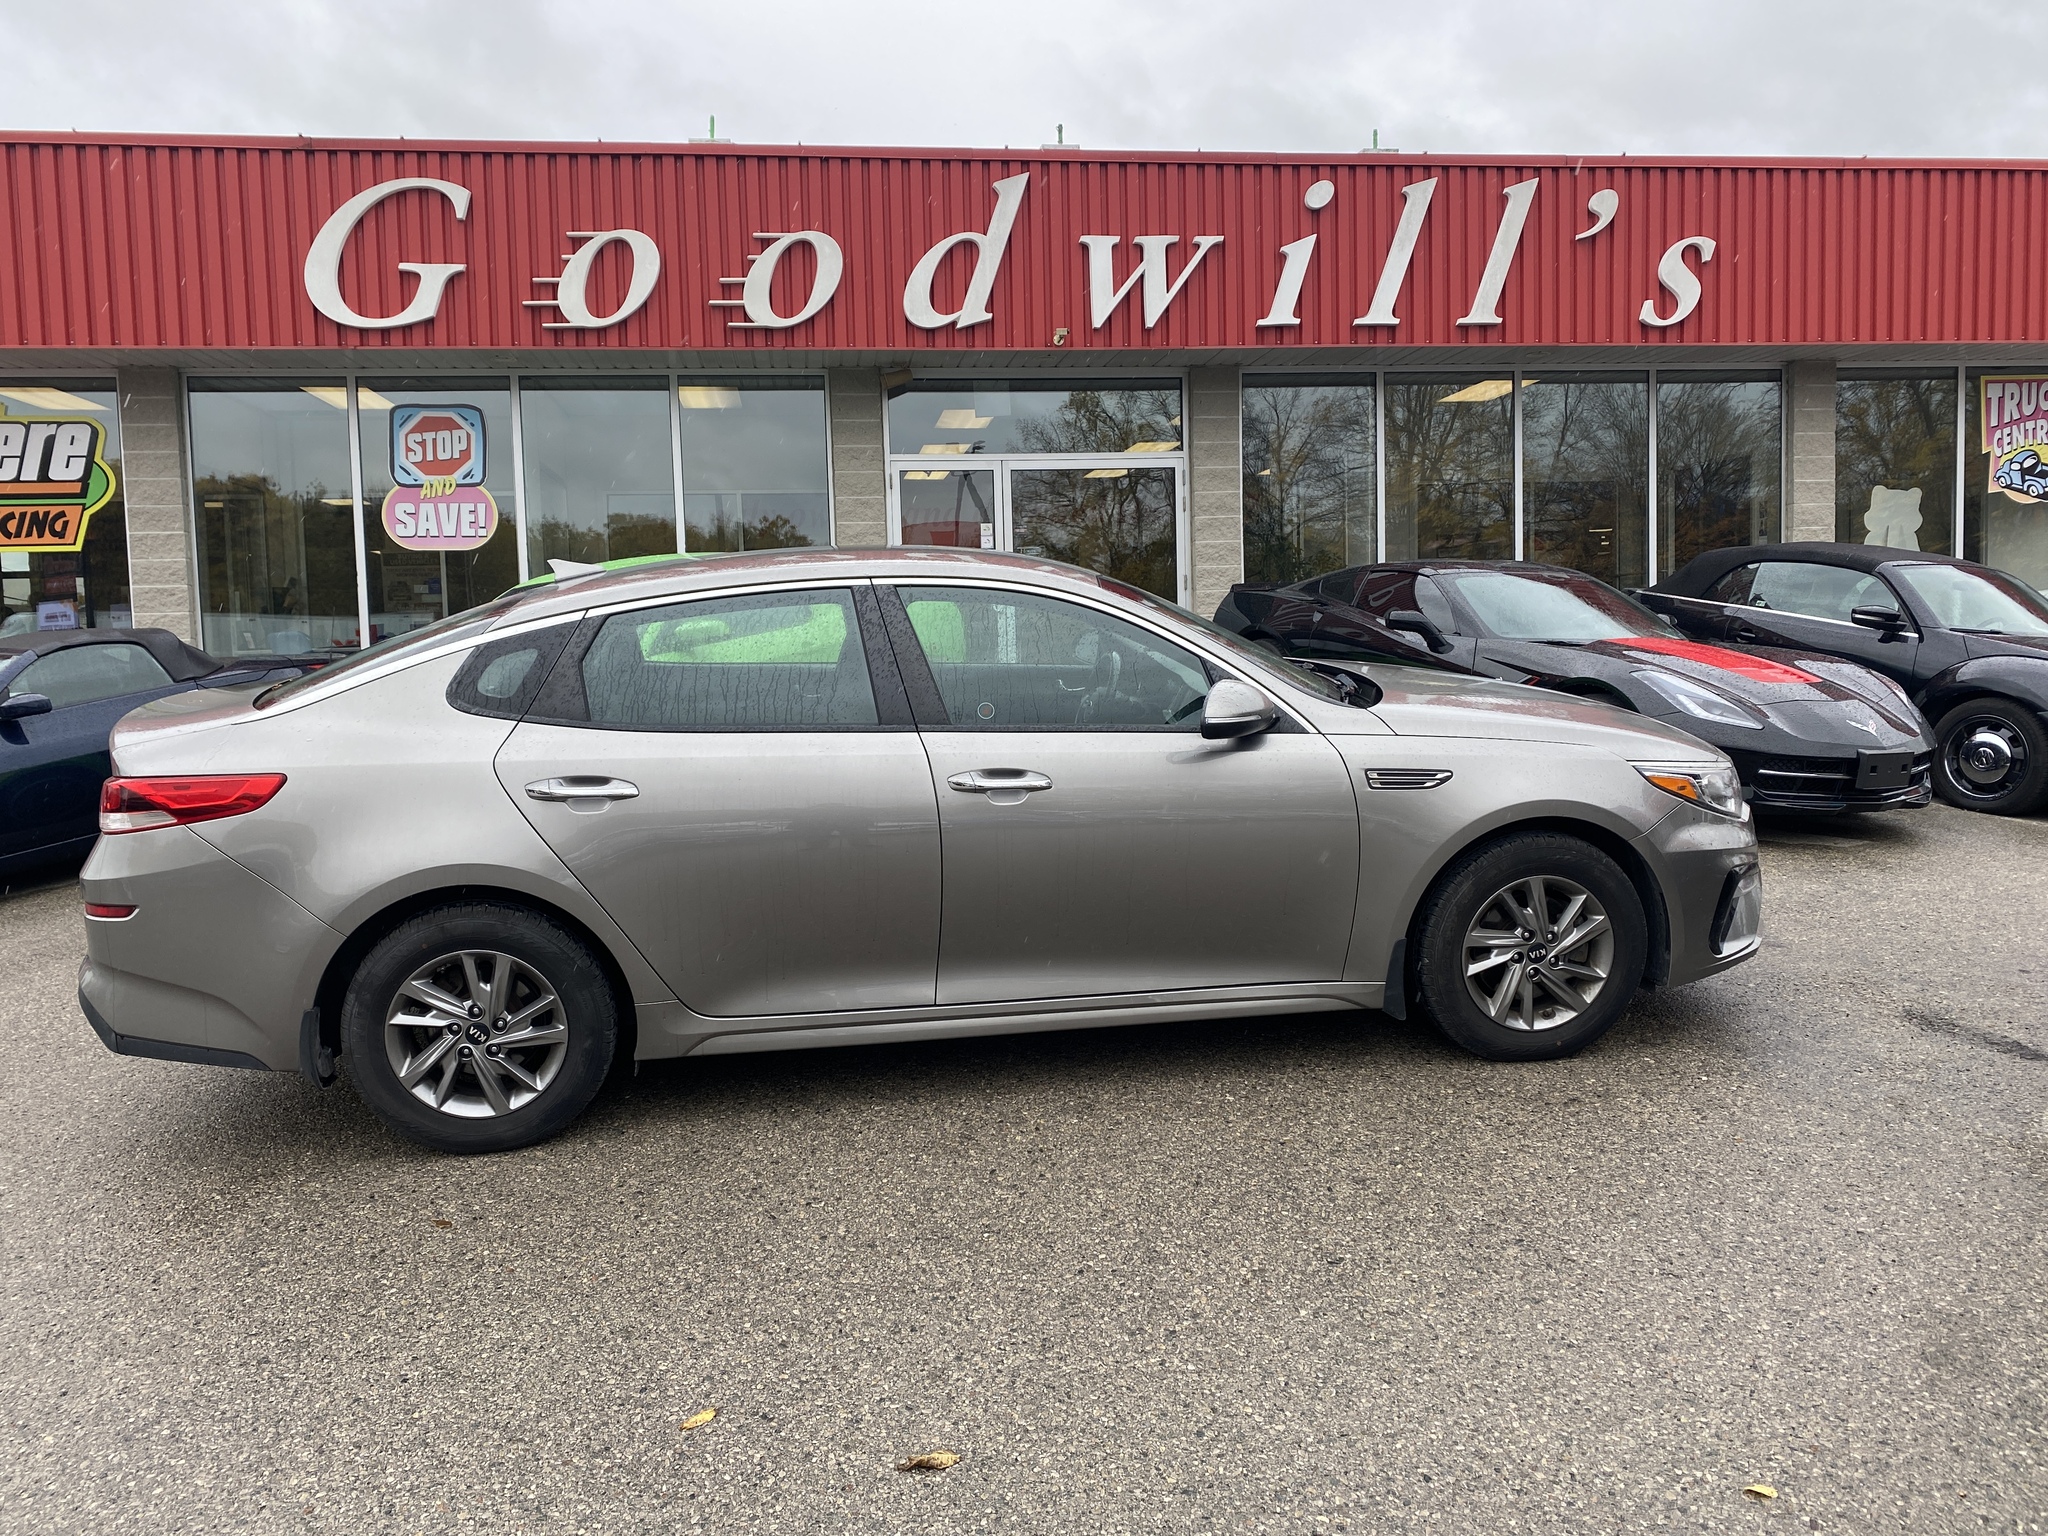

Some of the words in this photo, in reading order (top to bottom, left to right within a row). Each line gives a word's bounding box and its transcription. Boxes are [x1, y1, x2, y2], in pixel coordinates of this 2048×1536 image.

[304, 171, 1716, 330] Goodwill's
[407, 430, 467, 463] STOP
[420, 476, 457, 500] AND
[394, 502, 488, 538] SAVE!
[1529, 948, 1547, 959] KIA
[469, 1026, 487, 1042] KIA
